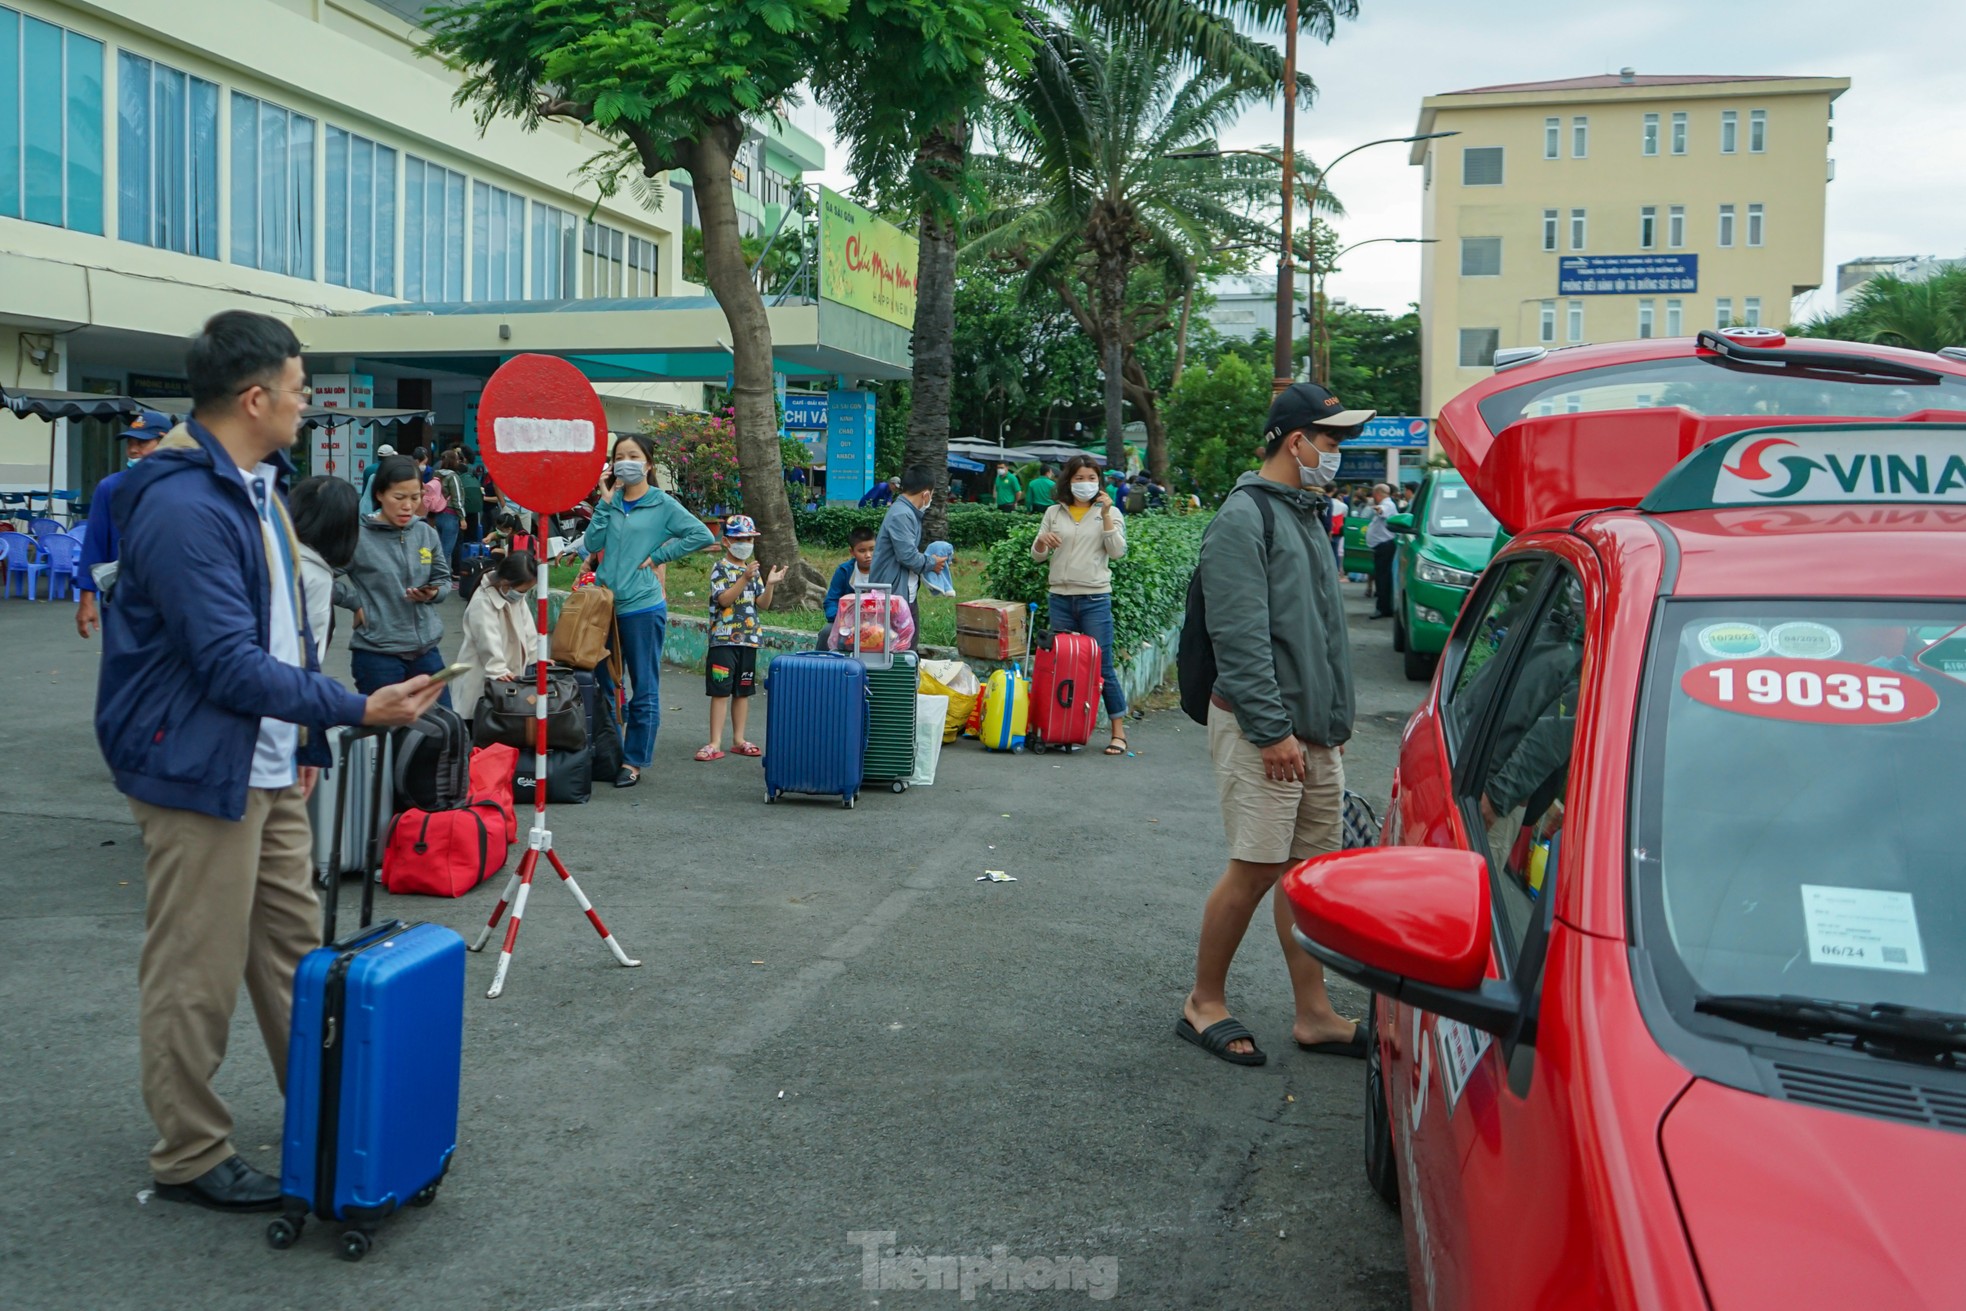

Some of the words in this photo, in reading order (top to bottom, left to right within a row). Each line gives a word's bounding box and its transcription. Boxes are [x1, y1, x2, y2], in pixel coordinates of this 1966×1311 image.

[785, 410, 807, 427] CHỊ
[1379, 425, 1405, 437] GÒN
[1709, 667, 1906, 713] 19035
[1821, 944, 1865, 957] 06/24
